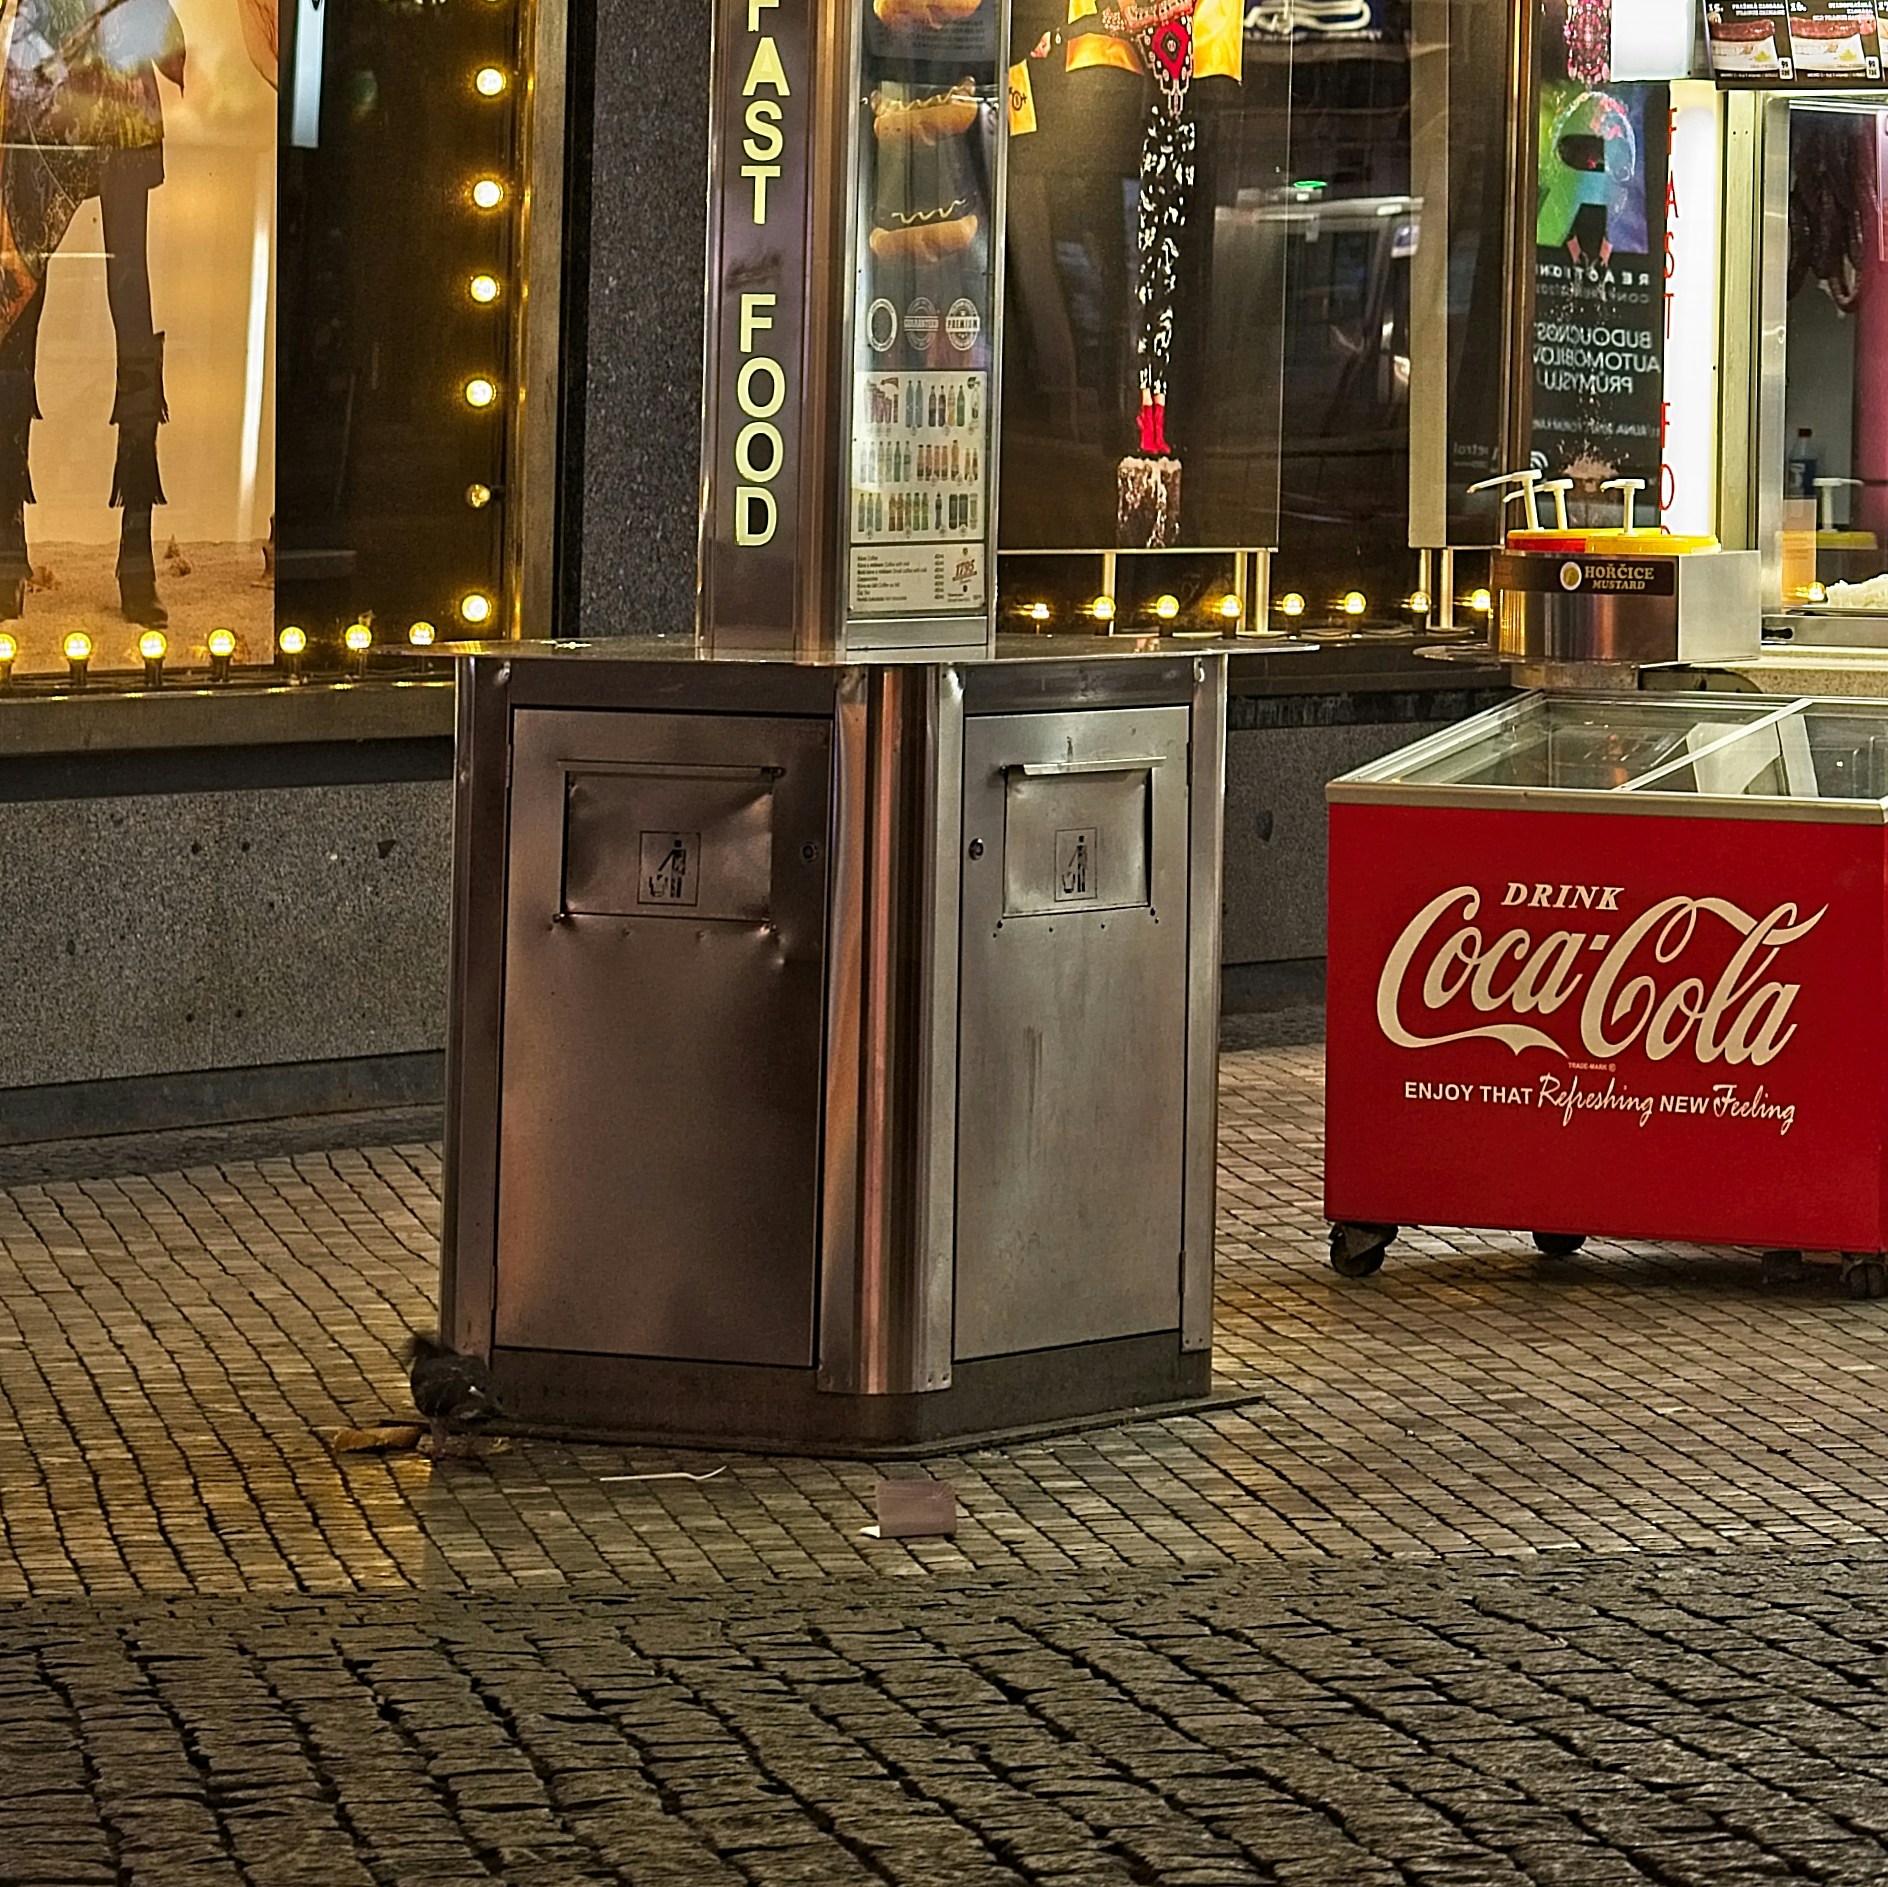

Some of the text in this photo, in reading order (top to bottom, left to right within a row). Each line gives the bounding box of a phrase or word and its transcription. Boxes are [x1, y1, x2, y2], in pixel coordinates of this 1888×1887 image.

[734, 292, 786, 548] FOOD
[1585, 564, 1655, 580] HOŘČICE
[1592, 580, 1646, 589] MUSTARD
[1501, 883, 1624, 910] DRINK
[1376, 886, 1829, 1066] Coca-Cola
[1568, 1062, 1607, 1071] TRADE-MARK
[1405, 1073, 1796, 1135] ENJOY THAT Refreshing NEW Feeling
